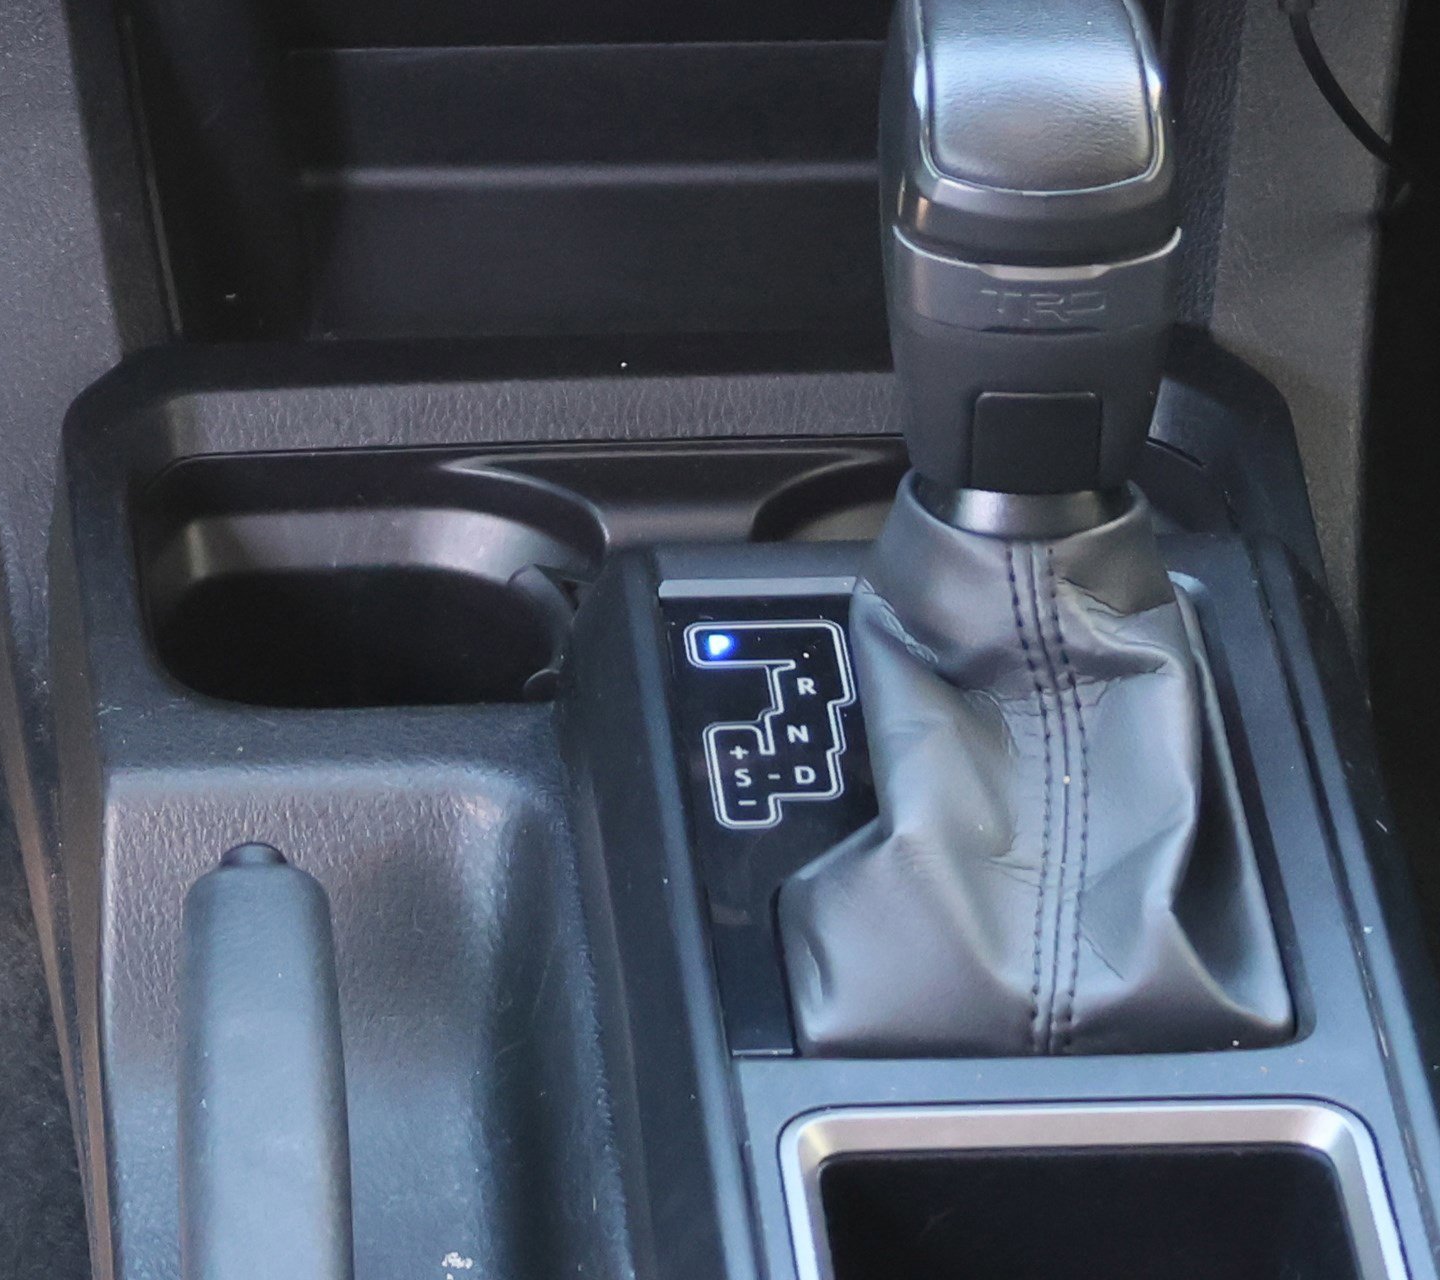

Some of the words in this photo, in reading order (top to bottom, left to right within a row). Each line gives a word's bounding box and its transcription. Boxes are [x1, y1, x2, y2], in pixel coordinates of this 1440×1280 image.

[796, 677, 817, 695] R
[786, 725, 809, 744] N
[735, 768, 752, 787] S
[794, 766, 816, 785] D
